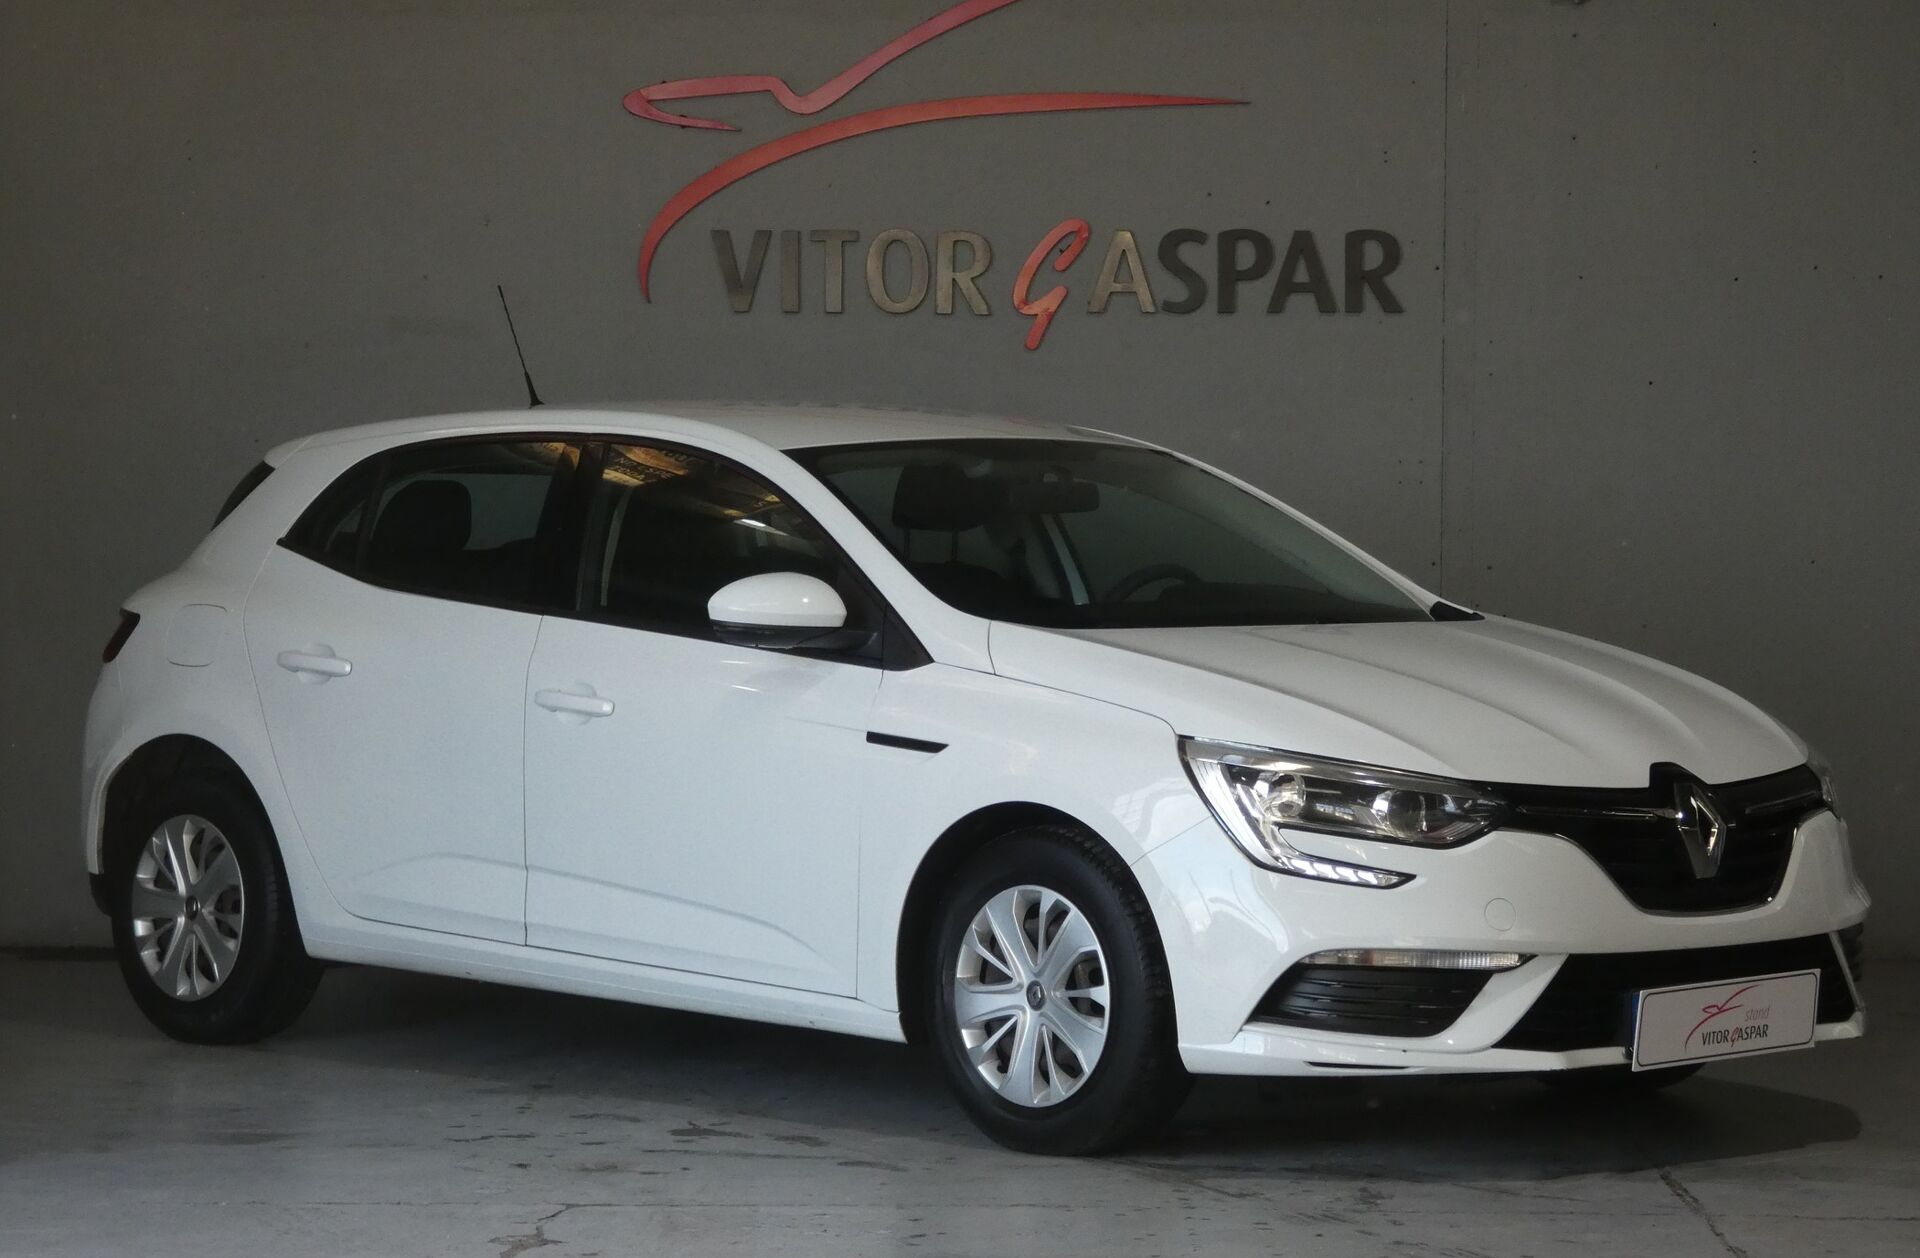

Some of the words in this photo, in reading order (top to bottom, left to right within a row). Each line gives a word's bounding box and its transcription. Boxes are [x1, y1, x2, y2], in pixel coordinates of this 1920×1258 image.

[709, 228, 992, 316] VITOR
[1013, 217, 1406, 351] GASPAR
[1702, 1030, 1730, 1046] VITOR
[1730, 1024, 1769, 1048] GASPAR
